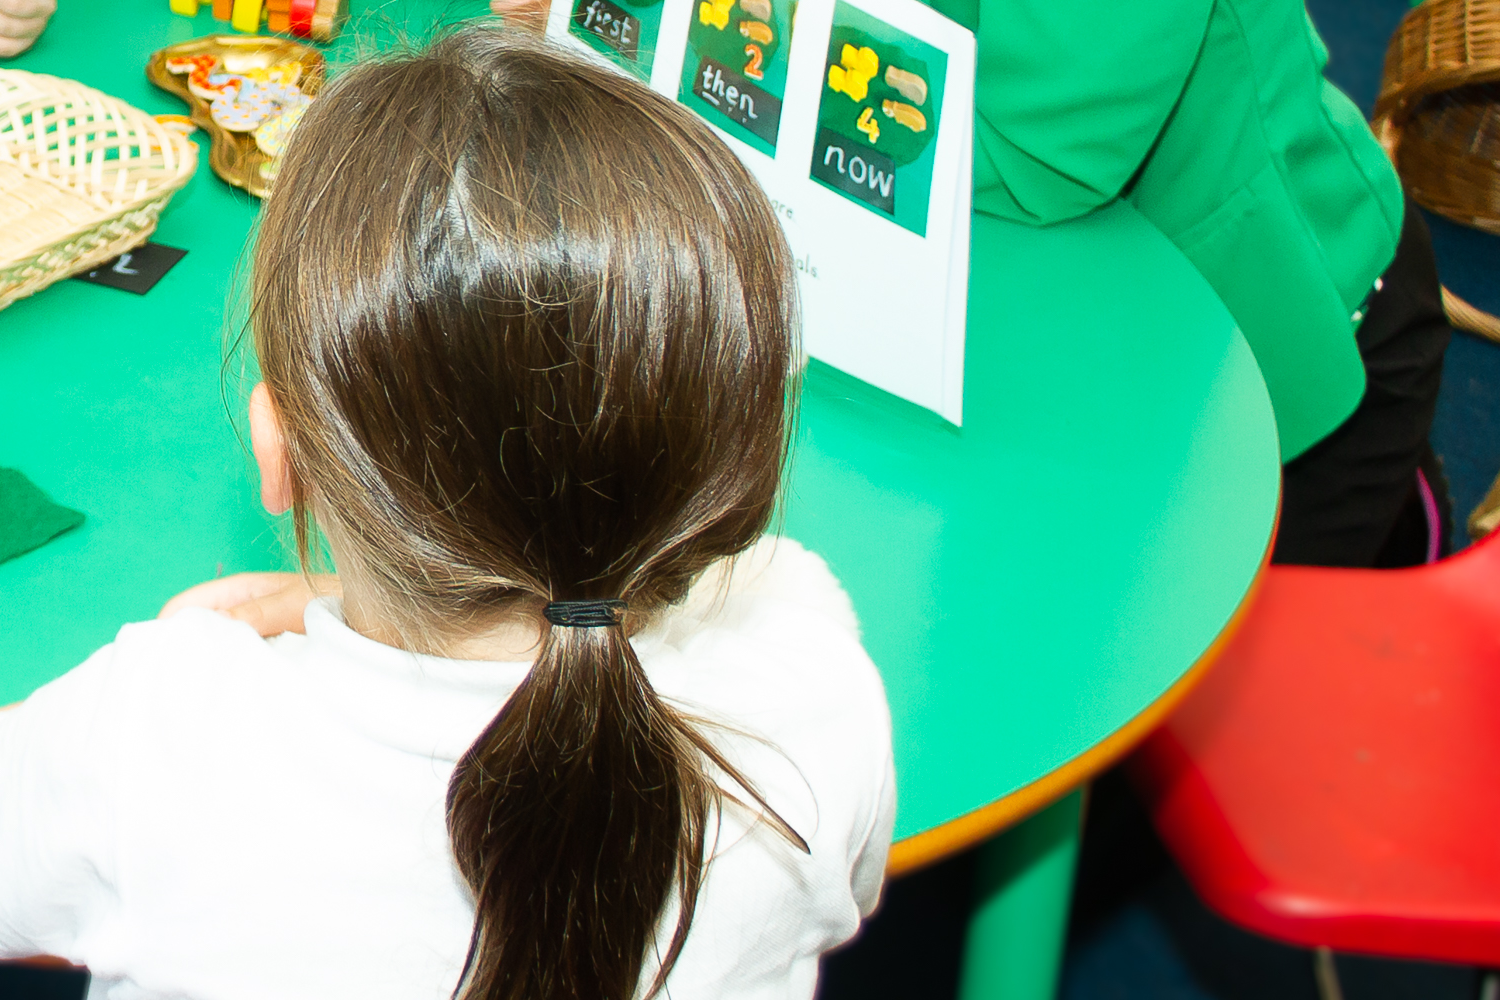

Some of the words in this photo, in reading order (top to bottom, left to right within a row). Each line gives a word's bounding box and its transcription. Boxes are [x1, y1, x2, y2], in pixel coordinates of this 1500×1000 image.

[583, 0, 632, 44] first
[743, 43, 764, 81] 2
[702, 64, 758, 119] then
[856, 106, 880, 144] 4
[823, 145, 894, 198] now
